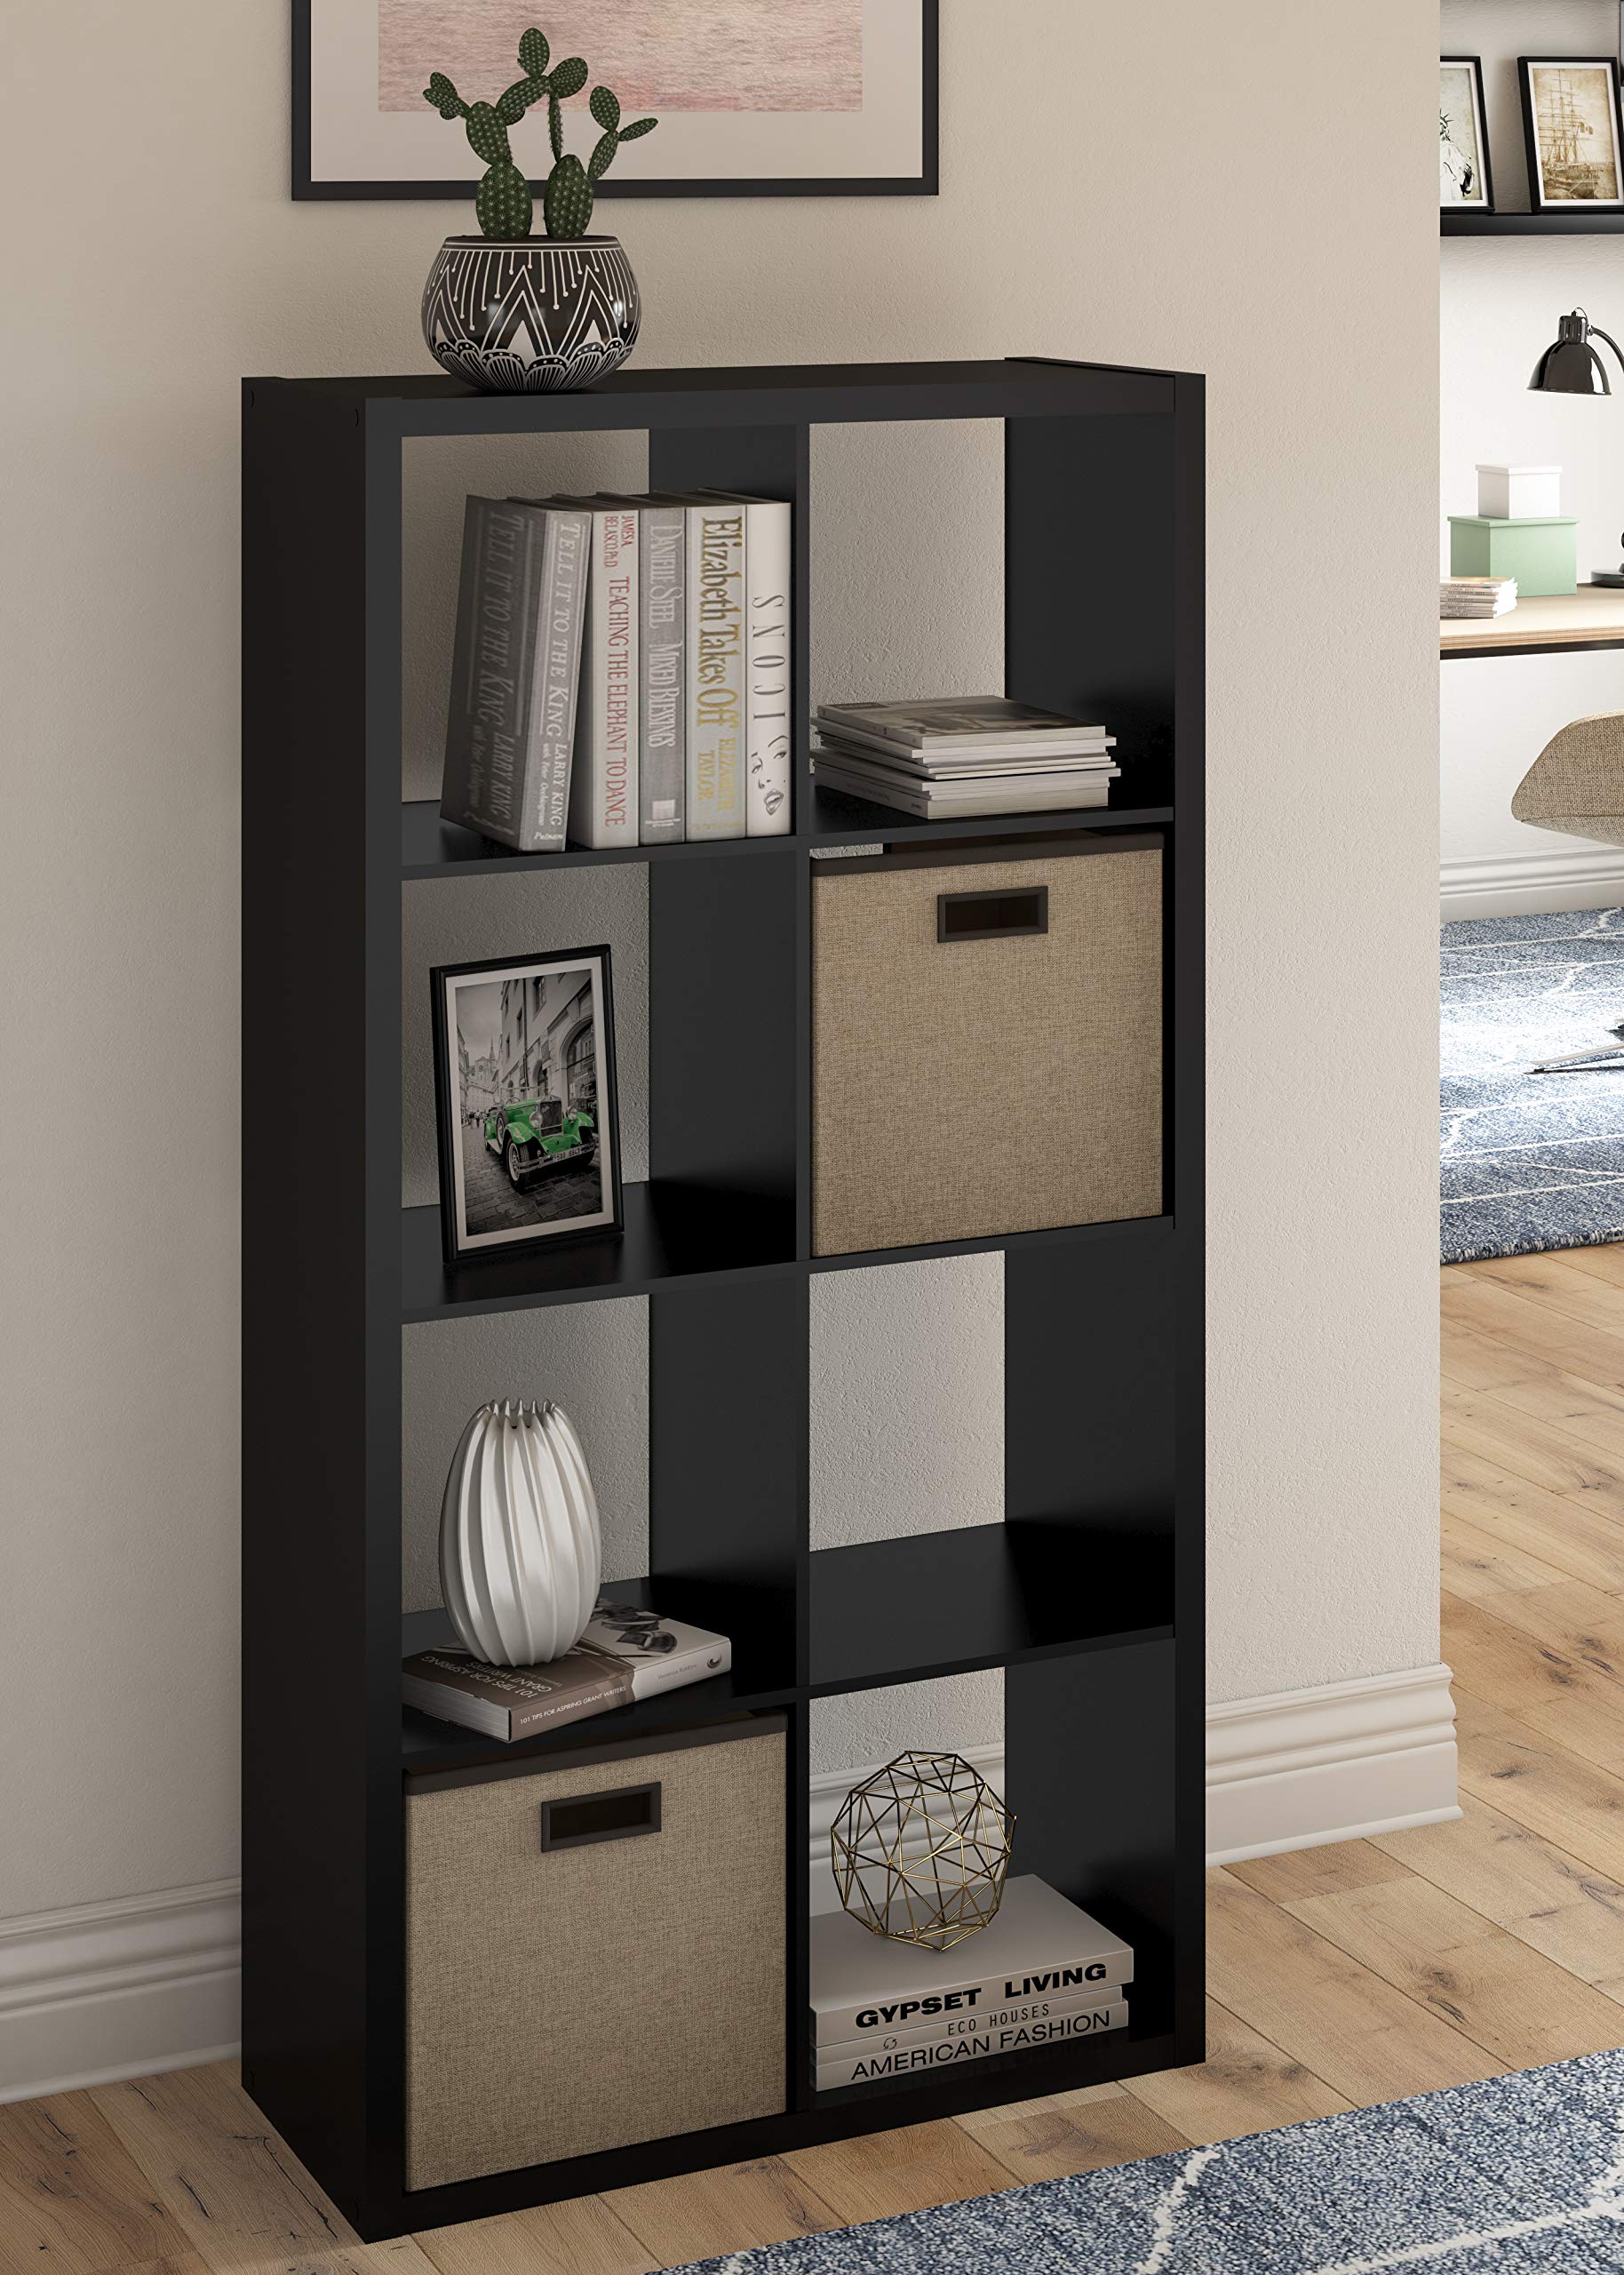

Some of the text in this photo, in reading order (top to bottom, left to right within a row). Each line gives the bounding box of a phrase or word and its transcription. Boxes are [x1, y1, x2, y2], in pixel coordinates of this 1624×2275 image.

[649, 525, 682, 629] DANIELLE STEEL
[478, 512, 524, 727] TELL IT TO THE KING
[545, 523, 580, 737] TELL IT TO THE KING
[697, 516, 743, 728] Elizabeth Takes Off
[752, 595, 786, 722] ICONS
[605, 576, 630, 826] TEACHING THE ELEPHANT TO DANCE
[648, 641, 682, 747] MIXED BLESSINGS
[490, 731, 515, 819] LARRY KING
[549, 743, 568, 826] LARRY KING
[697, 749, 716, 801] TAYLOR
[717, 738, 736, 811] ELIZABETH
[421, 1656, 538, 1698] 101 TIPS FOR ASPIRING
[466, 1661, 512, 1680] WRITERS
[509, 1677, 553, 1692] GRANT
[520, 1685, 627, 1725] 101 TIPS FOR ASPIRING GRANT WRITERS
[856, 1963, 1107, 2029] GYPSET LIVING
[948, 2003, 1049, 2036] ECO HOUSES
[851, 2010, 1111, 2080] AMERICAN FASHION
